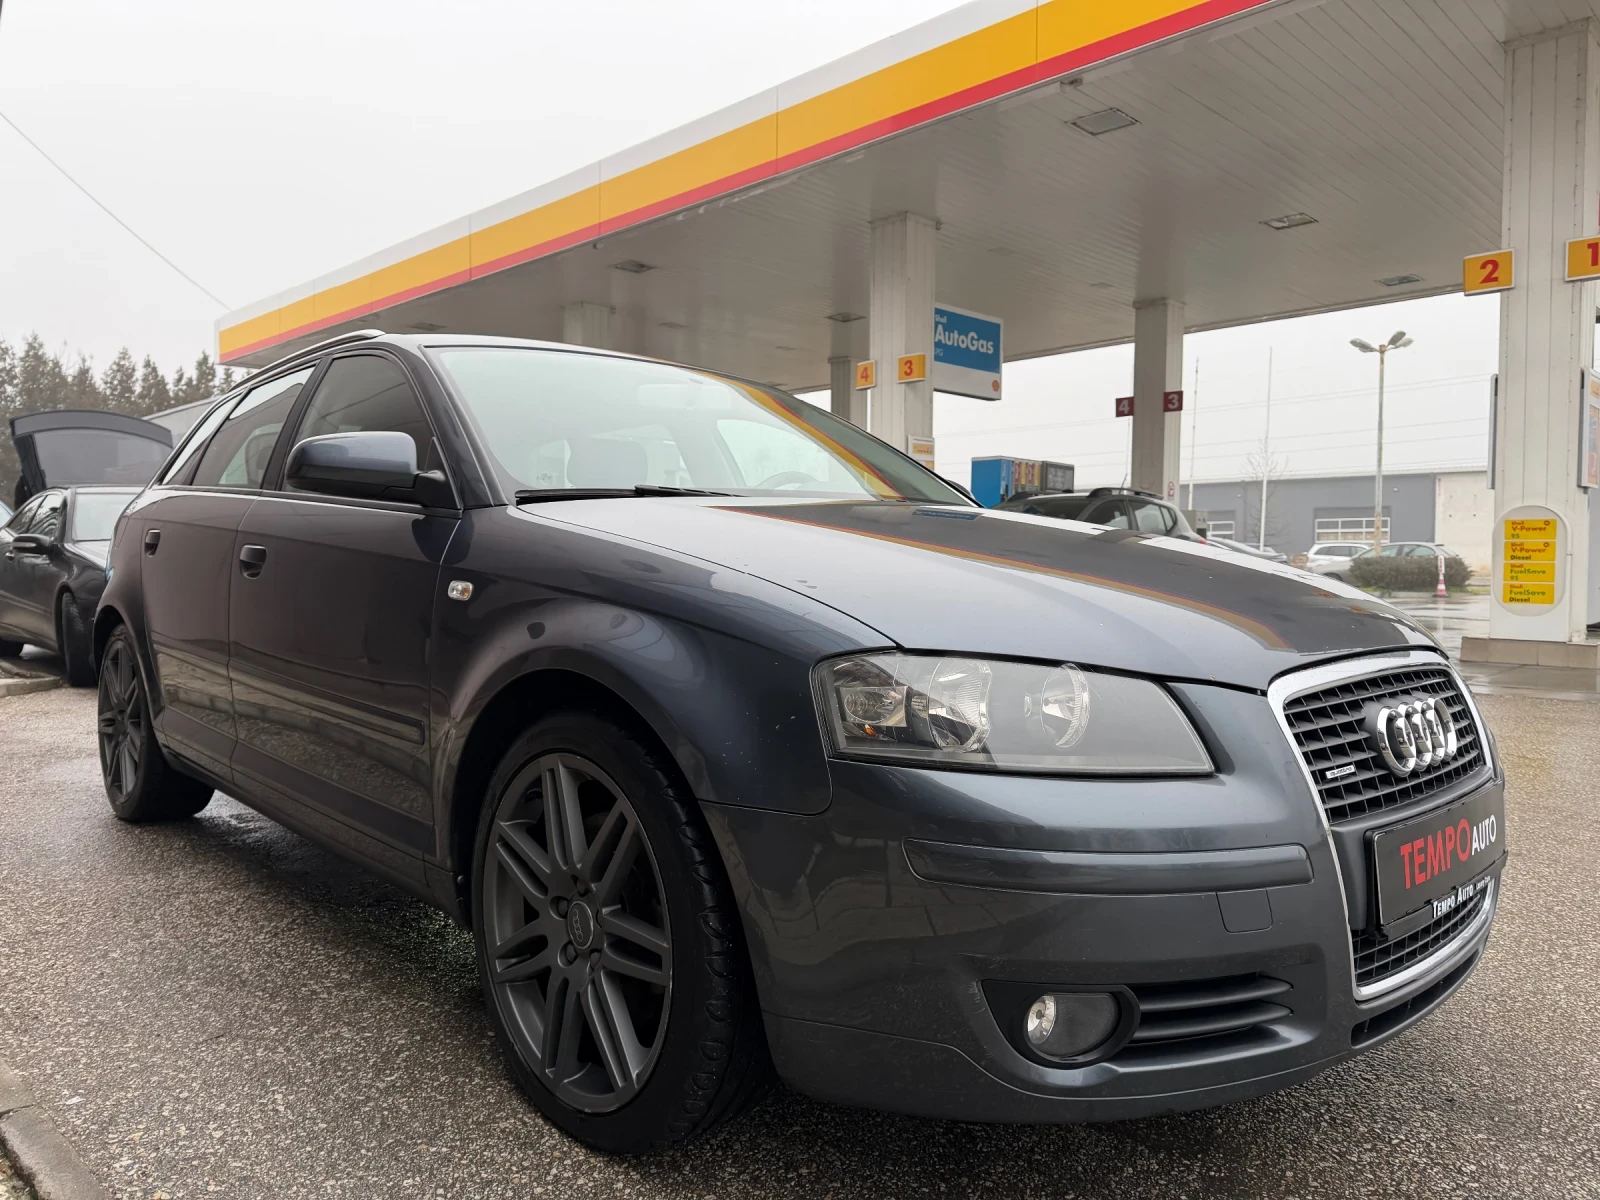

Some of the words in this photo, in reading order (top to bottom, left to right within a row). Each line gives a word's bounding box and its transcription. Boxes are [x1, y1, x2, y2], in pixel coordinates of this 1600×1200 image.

[1587, 242, 1600, 267] 1
[1479, 259, 1499, 284] 2
[934, 324, 994, 354] AutoGas
[860, 366, 869, 382] 4
[903, 359, 914, 376] 3
[1118, 399, 1130, 414] 4
[1167, 393, 1179, 410] 3
[1400, 818, 1471, 889] TEMPO
[1472, 814, 1497, 856] AUTO
